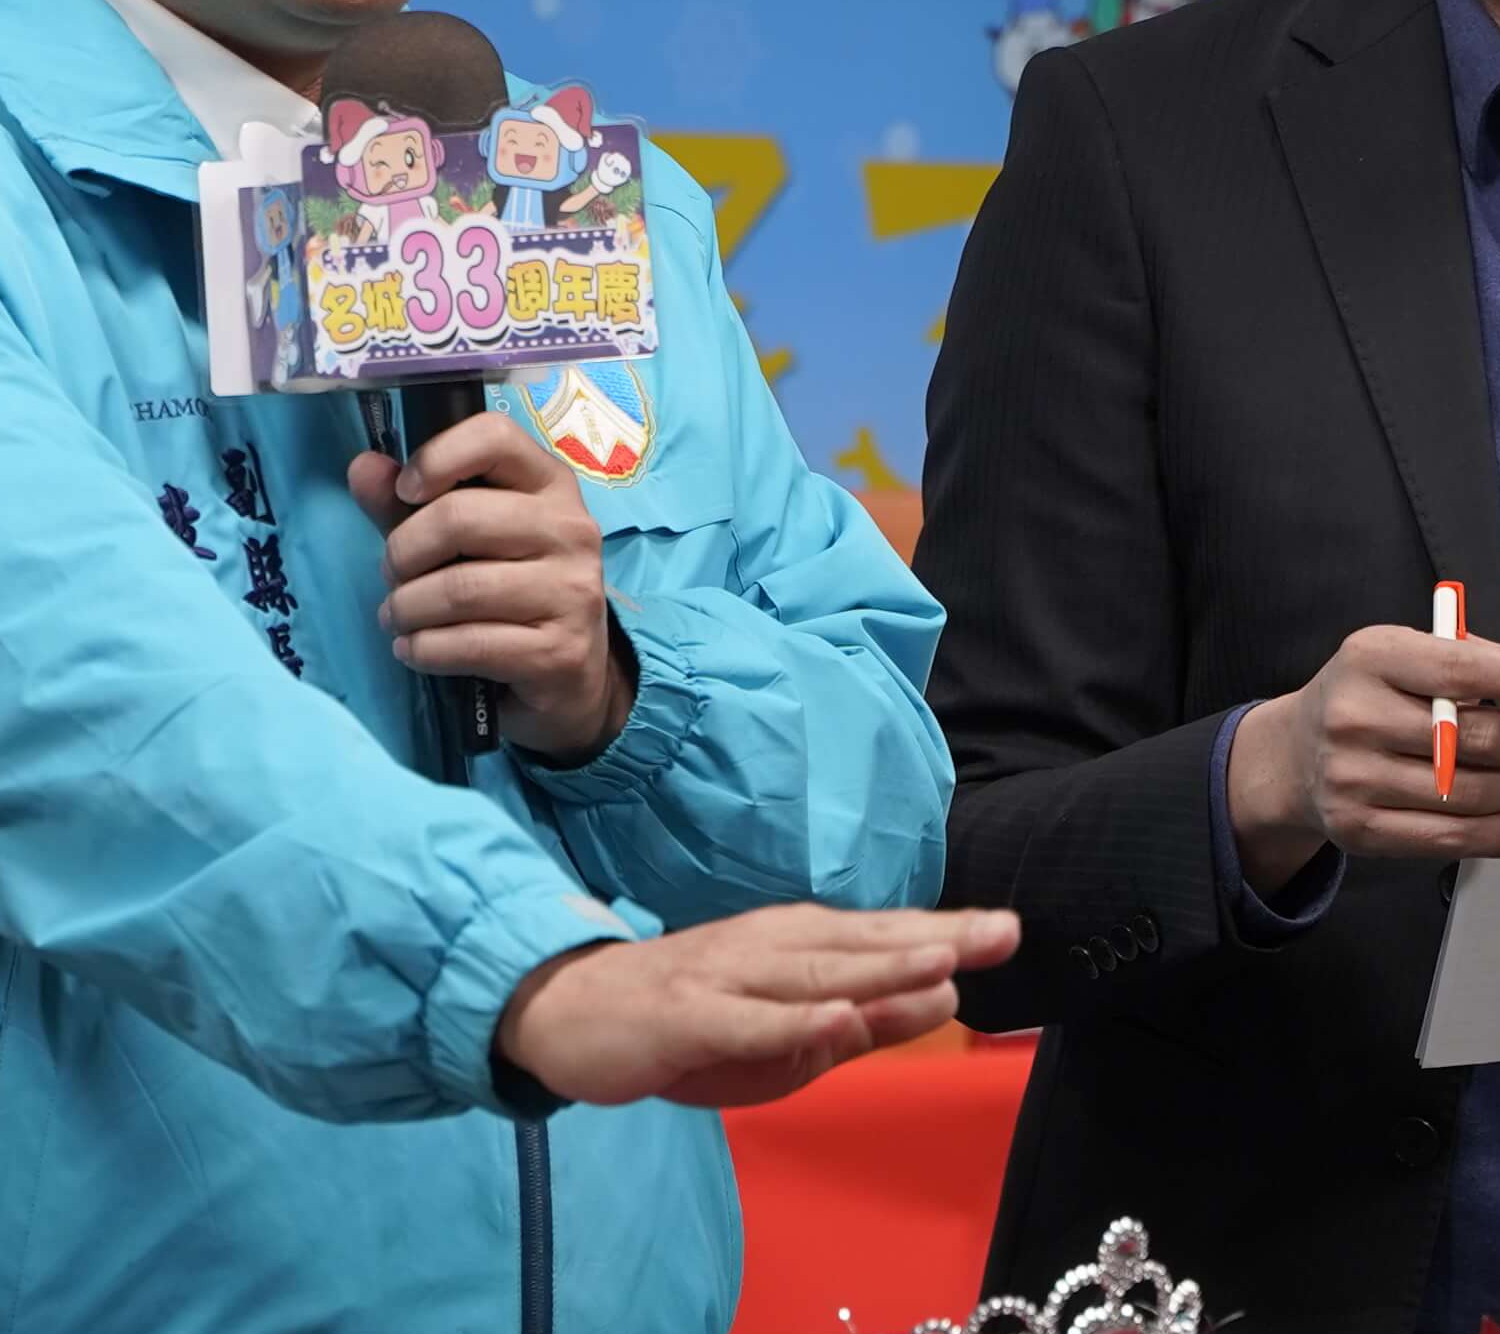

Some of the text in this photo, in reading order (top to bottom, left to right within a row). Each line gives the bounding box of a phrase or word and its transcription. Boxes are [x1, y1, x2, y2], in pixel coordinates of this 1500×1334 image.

[319, 225, 642, 345] 名城33週年慶
[129, 395, 208, 423] HAMO
